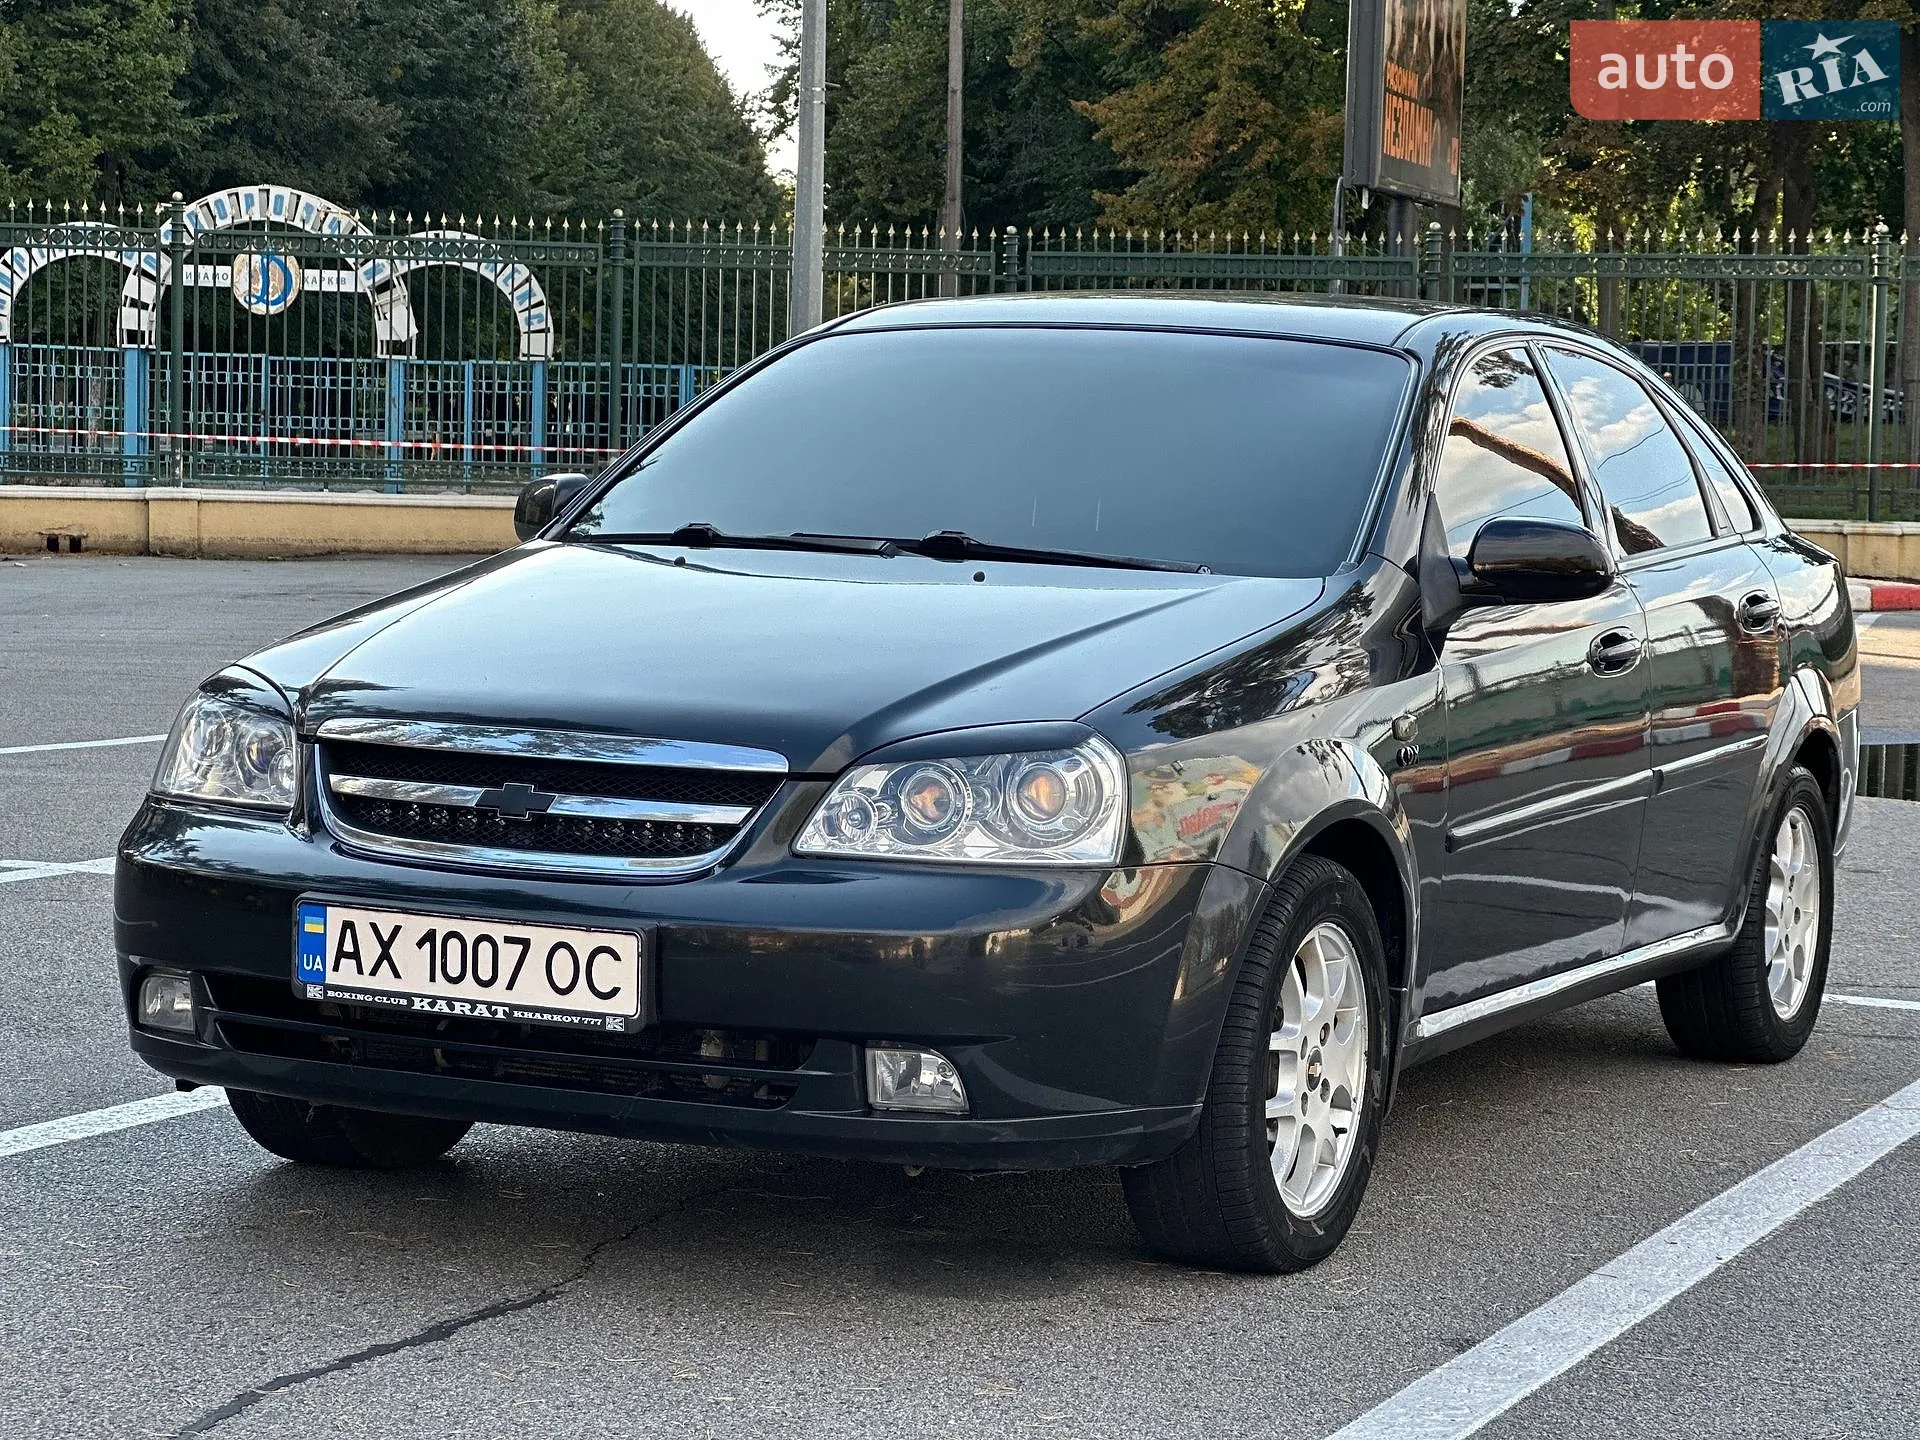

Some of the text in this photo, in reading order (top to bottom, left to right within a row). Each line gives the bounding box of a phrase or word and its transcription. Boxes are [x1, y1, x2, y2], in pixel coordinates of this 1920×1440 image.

[1383, 92, 1433, 168] НЕЗЛАМНІ
[303, 275, 346, 286] ХАРКВ
[303, 954, 324, 973] UA
[331, 919, 622, 1000] AX 1007 OC
[326, 989, 374, 1002] BOXING
[374, 995, 408, 1006] CLUB
[410, 996, 510, 1020] KARAT
[512, 1010, 582, 1025] KHARKOV
[582, 1017, 603, 1026] 777
